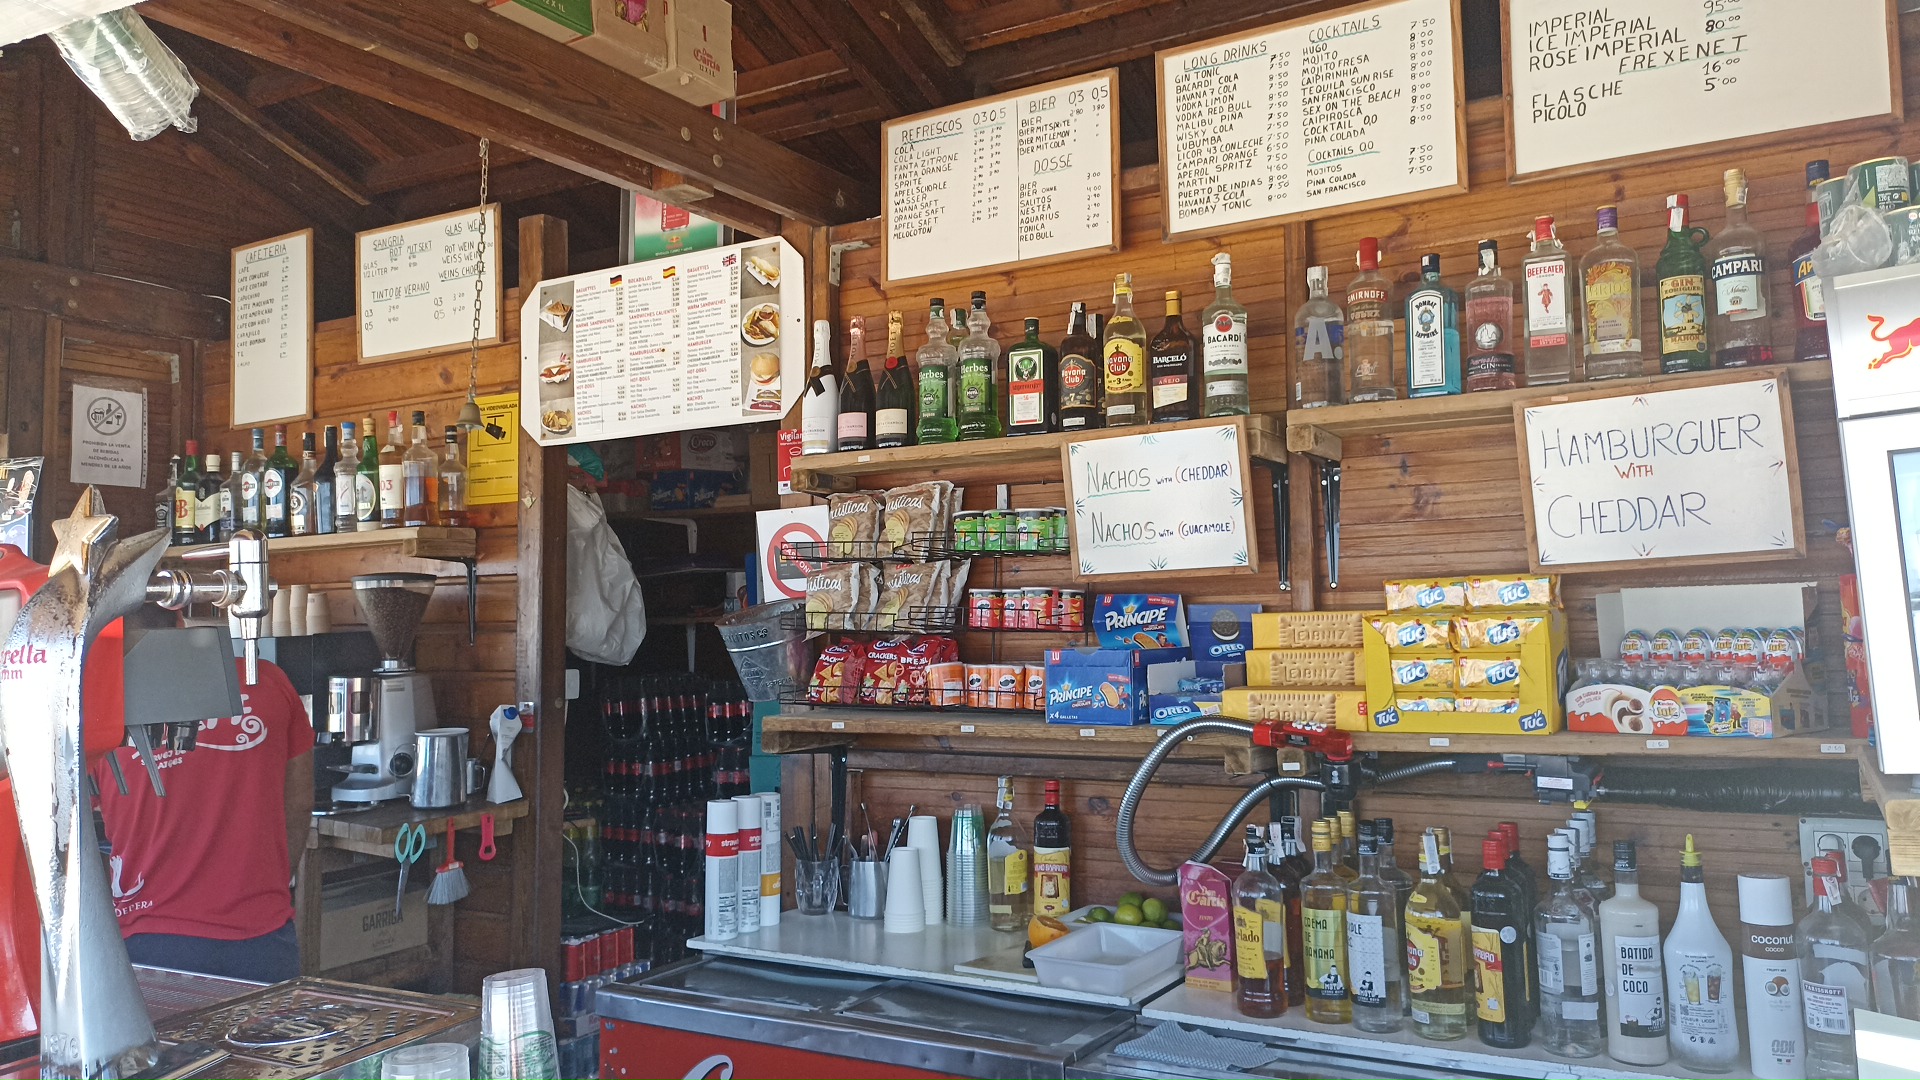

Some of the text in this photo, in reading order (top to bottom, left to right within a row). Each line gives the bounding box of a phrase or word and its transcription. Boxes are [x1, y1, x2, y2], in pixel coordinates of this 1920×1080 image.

[1308, 14, 1380, 44] COCKTAILS
[1528, 7, 1616, 38] IMPERIAL
[1529, 15, 1657, 54] ICE IMPERIAL
[1183, 43, 1268, 71] LONG DRINKS
[1302, 42, 1328, 56] HUGO
[1529, 27, 1687, 73] ROSE IMPERIAL
[1618, 34, 1748, 73] FREXENET
[1301, 54, 1370, 78] MOJITO FRESA
[1302, 50, 1338, 66] MOJITO
[1175, 66, 1220, 84] GIN TONIC
[1175, 73, 1239, 94] BACARDI COLA
[1301, 80, 1345, 97] TEQUILA
[1176, 90, 1207, 103] HAVANA
[1217, 83, 1238, 95] COLA
[1532, 80, 1624, 109] FLASCHE
[1029, 95, 1056, 113] BIER
[1176, 94, 1235, 112] VODKA LIMON
[1302, 88, 1401, 116] SEX ON THE BEACH
[1176, 100, 1252, 122] VODKA RED BULL
[1302, 107, 1363, 127] CAIPIROSCA
[1532, 101, 1587, 124] PICOLO
[902, 117, 963, 142] REFRESCOS
[1021, 116, 1042, 128] BIER
[1176, 118, 1213, 132] MALIBU
[1303, 120, 1353, 137] COCKTAIL
[1176, 124, 1234, 141] WISKY COLA
[1330, 127, 1366, 142] COLADA
[894, 143, 915, 155] COLA
[1176, 135, 1222, 152] LUBUMBA
[893, 147, 941, 164] COLA LIGHT
[894, 152, 959, 172] FANTA ZITRONE
[1177, 146, 1217, 162] LICOR 43
[1177, 148, 1258, 171] CAMPARI ORANGE
[1033, 153, 1073, 174] DOSSE
[1177, 159, 1252, 179] APEROL SPRITZ
[894, 163, 953, 181] FANTA ORANGE
[1329, 172, 1357, 183] COLADA
[894, 178, 922, 189] SPRITE
[1178, 175, 1219, 189] MARTINI
[1178, 178, 1263, 199] PUERTO DE INDIAS
[1324, 179, 1366, 194] FRANCISCO
[894, 194, 928, 206] WASSER
[894, 199, 939, 214] ANANA SAFT
[1020, 195, 1052, 207] SALITOS
[1178, 189, 1245, 209] HAVANA 3 COLA
[1020, 204, 1052, 216] NESTEA
[1179, 199, 1252, 219] BOMBAY TONIC
[894, 216, 939, 231] APFEL SAFT
[1020, 211, 1060, 225] AQUARIUS
[444, 222, 463, 235] GLAS
[893, 227, 932, 240] MELOCOTON
[1019, 222, 1046, 234] TONICA
[372, 234, 405, 249] SANGRIA
[457, 241, 475, 251] WEIN
[245, 243, 287, 263] CAFETERIA
[1526, 264, 1564, 278] BEEFEATER
[1711, 260, 1762, 280] CAMPARI
[372, 289, 393, 300] TINTO
[404, 281, 430, 295] VERANO
[1670, 278, 1694, 288] GIN
[1347, 290, 1385, 304] SMIRNOFF
[1109, 362, 1126, 373] Club
[1480, 362, 1496, 370] GIN
[1064, 374, 1080, 384] Club
[1158, 377, 1180, 385] AÑEJO
[1541, 413, 1764, 469] HAMBURGUER
[1086, 461, 1151, 494] NACHOS
[1547, 491, 1712, 539] CHEDDAR
[1091, 511, 1157, 544] NACHOS
[1418, 591, 1443, 605] TUC
[1501, 586, 1527, 602] TUC
[1290, 627, 1352, 643] LEIBNIZ
[867, 652, 898, 660] CRACKERS
[1051, 652, 1060, 661] LU
[1210, 644, 1245, 656] OREO
[1283, 665, 1340, 680] LEIBNIZ
[1399, 665, 1426, 680] TUC
[1487, 667, 1516, 681] TUC
[1154, 704, 1192, 721] OREO
[1751, 934, 1794, 945] coconut
[1620, 946, 1654, 960] BATIDA
[1621, 963, 1634, 976] DE
[1622, 979, 1649, 993] COCO
[1771, 1039, 1796, 1054] ODK
